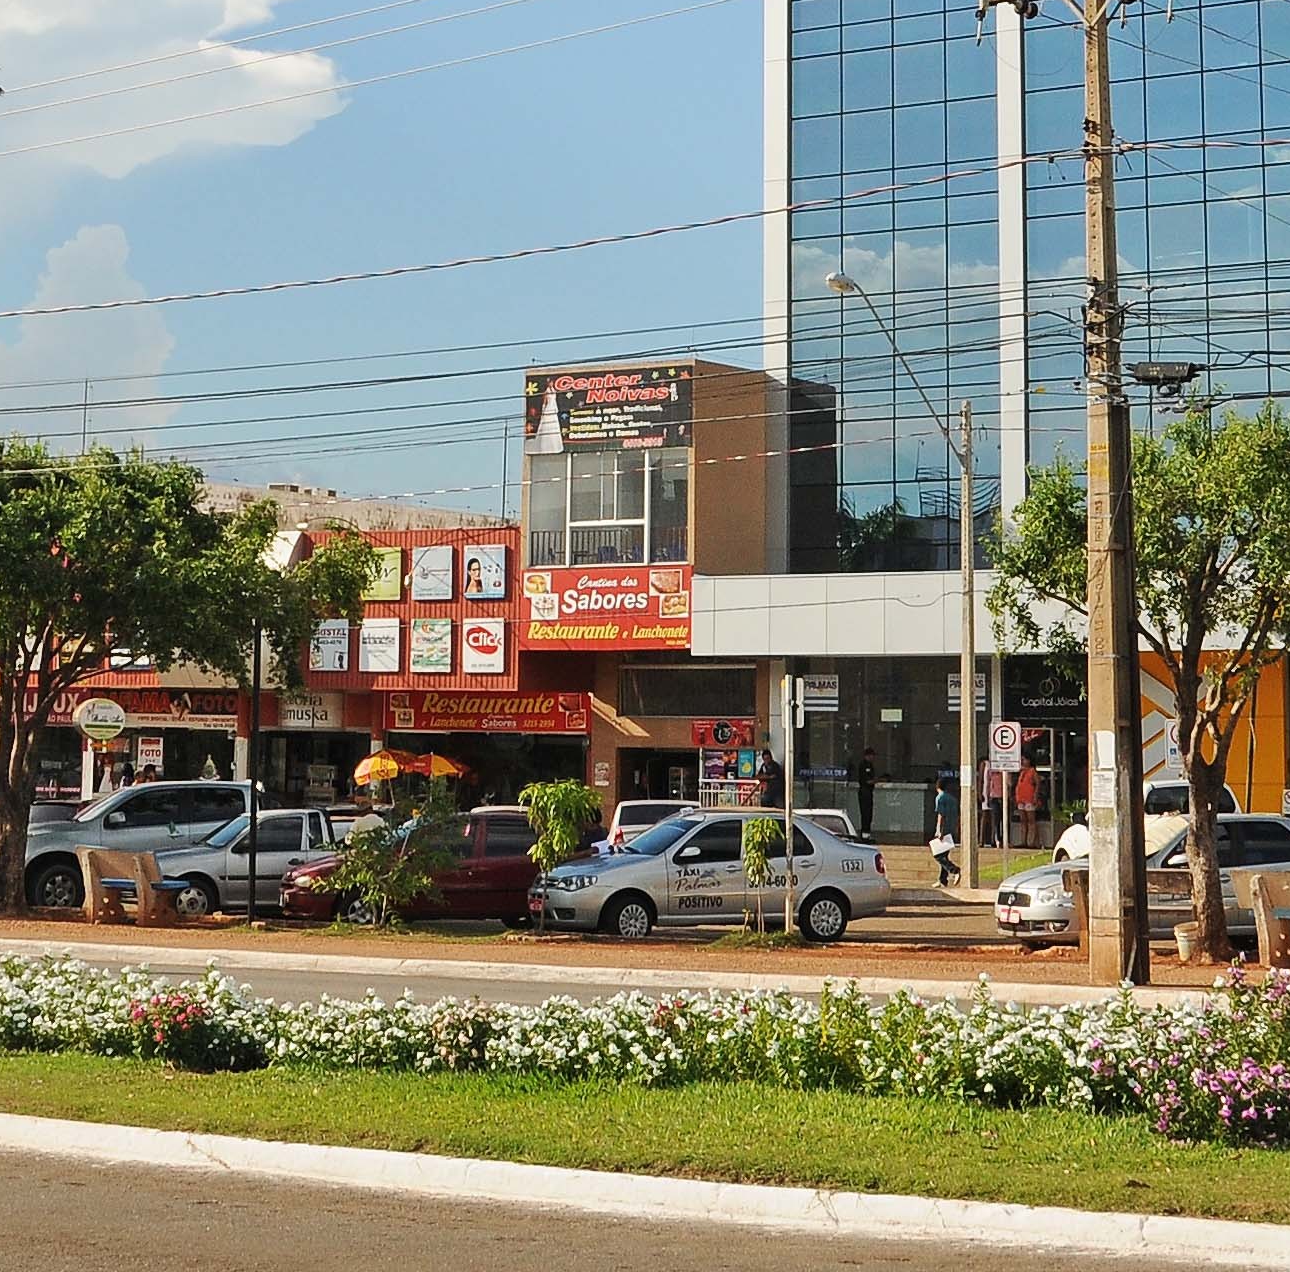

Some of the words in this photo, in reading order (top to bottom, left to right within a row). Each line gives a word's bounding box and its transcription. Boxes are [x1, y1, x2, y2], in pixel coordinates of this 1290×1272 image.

[554, 374, 642, 391] Center
[586, 386, 670, 404] Noivas
[621, 576, 638, 587] dos
[561, 588, 648, 614] Sabores
[528, 621, 619, 640] Restaurante
[632, 624, 688, 639] Lanchonete
[469, 632, 502, 647] Click
[804, 680, 838, 690] PALMAS
[192, 694, 237, 711] FOTO
[421, 692, 555, 714] Restaurante
[1021, 697, 1054, 707] Capital
[430, 717, 477, 728] Lanchonete
[481, 718, 517, 728] Sabores
[1000, 730, 1009, 745] E
[140, 749, 161, 757] FOTO
[676, 868, 700, 877] TAXI
[843, 860, 861, 871] 132
[675, 878, 720, 892] Palmas
[678, 896, 723, 909] POSITIVO
